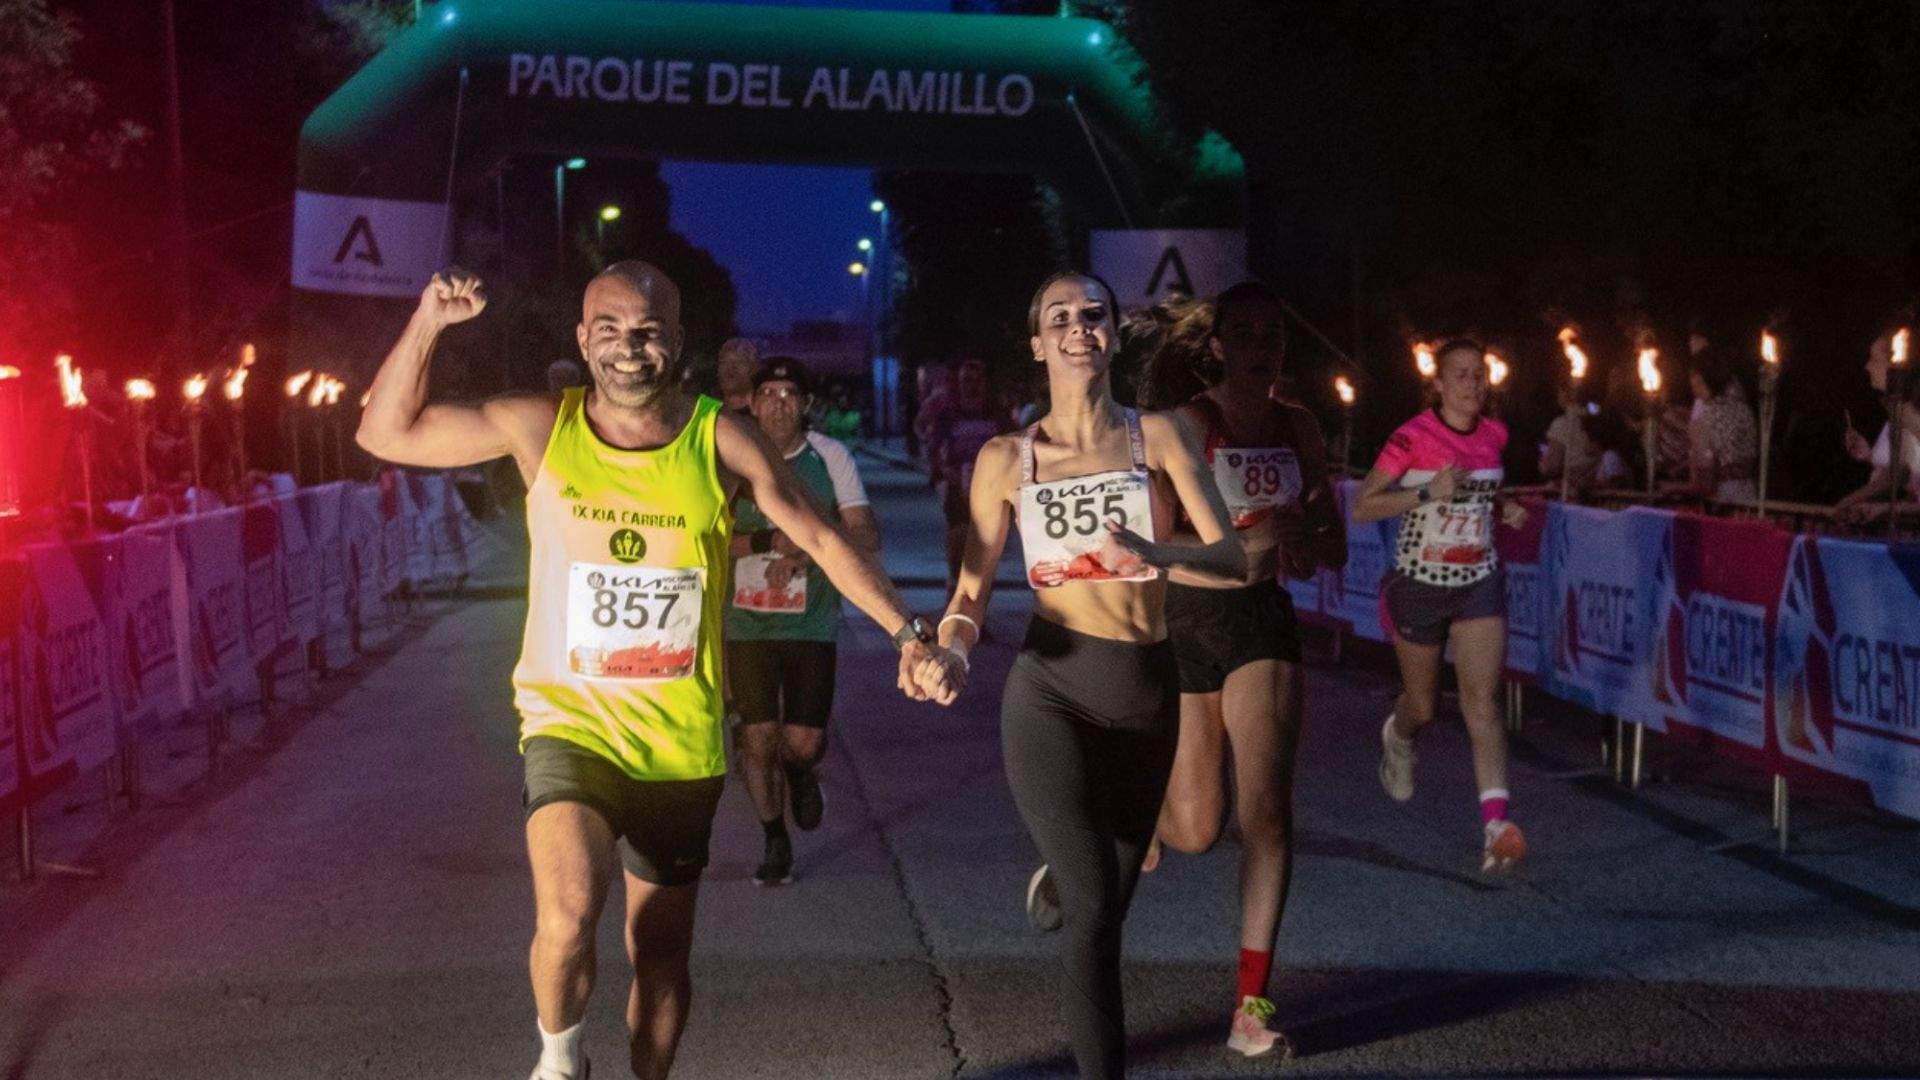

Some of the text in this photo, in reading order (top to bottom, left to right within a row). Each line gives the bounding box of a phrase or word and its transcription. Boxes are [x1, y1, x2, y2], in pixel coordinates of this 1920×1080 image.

[508, 53, 1035, 118] PARQUE DEL ALAMILLO
[1058, 482, 1105, 498] KIA
[1244, 465, 1280, 496] 89
[573, 506, 687, 529] IX KIA CARRERA
[1044, 494, 1128, 539] 855
[1440, 514, 1483, 536] 771
[611, 576, 662, 589] KIA
[592, 590, 680, 630] 857
[1579, 581, 1634, 652] CREATE
[1688, 600, 1763, 689] CREATE
